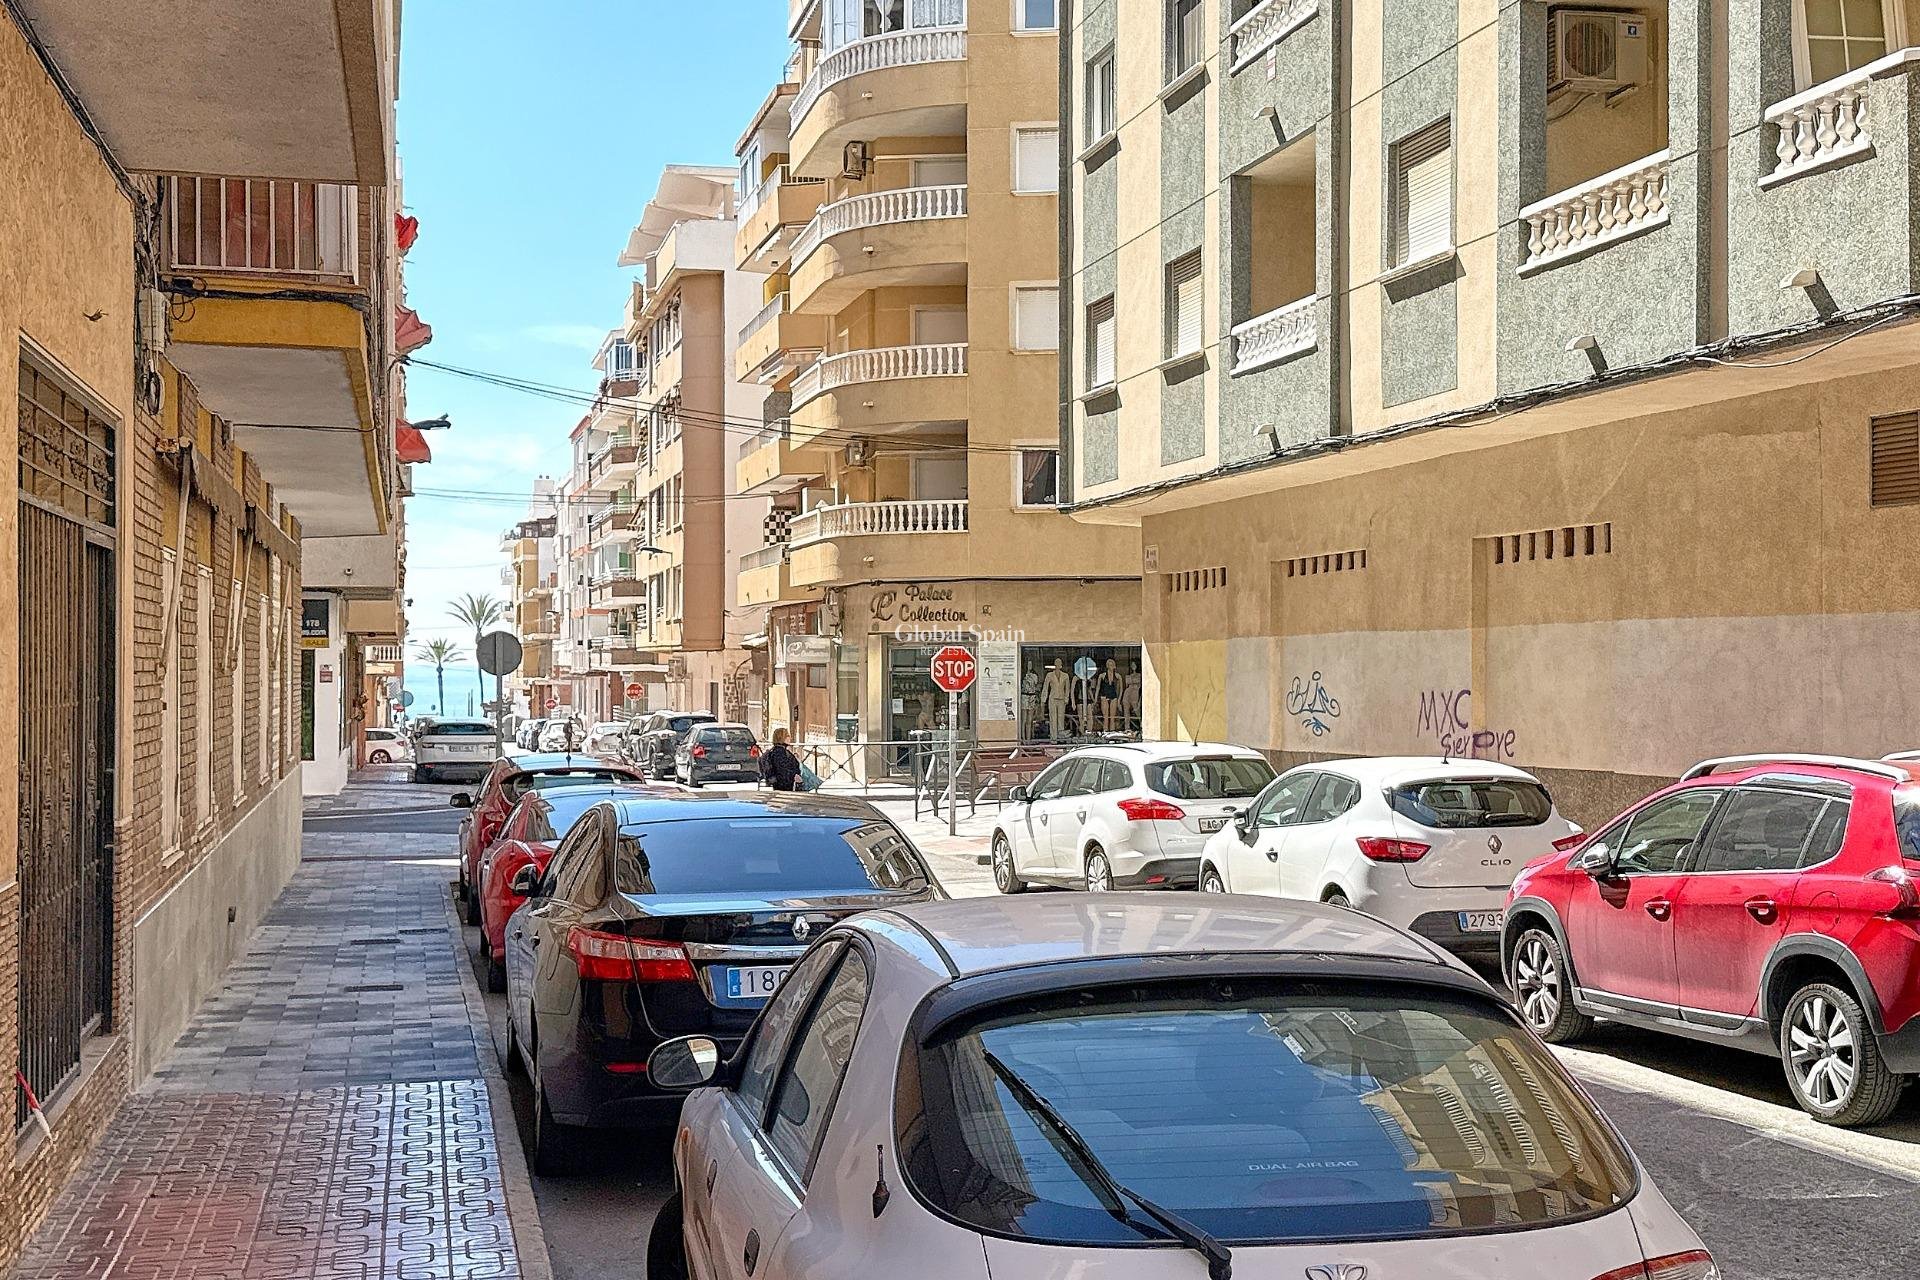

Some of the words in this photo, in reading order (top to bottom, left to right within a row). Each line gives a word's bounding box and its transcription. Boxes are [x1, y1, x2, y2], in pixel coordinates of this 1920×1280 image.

[905, 584, 953, 602] Palace
[899, 604, 968, 622] Collection
[934, 660, 975, 678] STOP
[1416, 689, 1472, 738] MXC
[1469, 912, 1503, 928] 2793
[1248, 1163, 1290, 1171] DUAL
